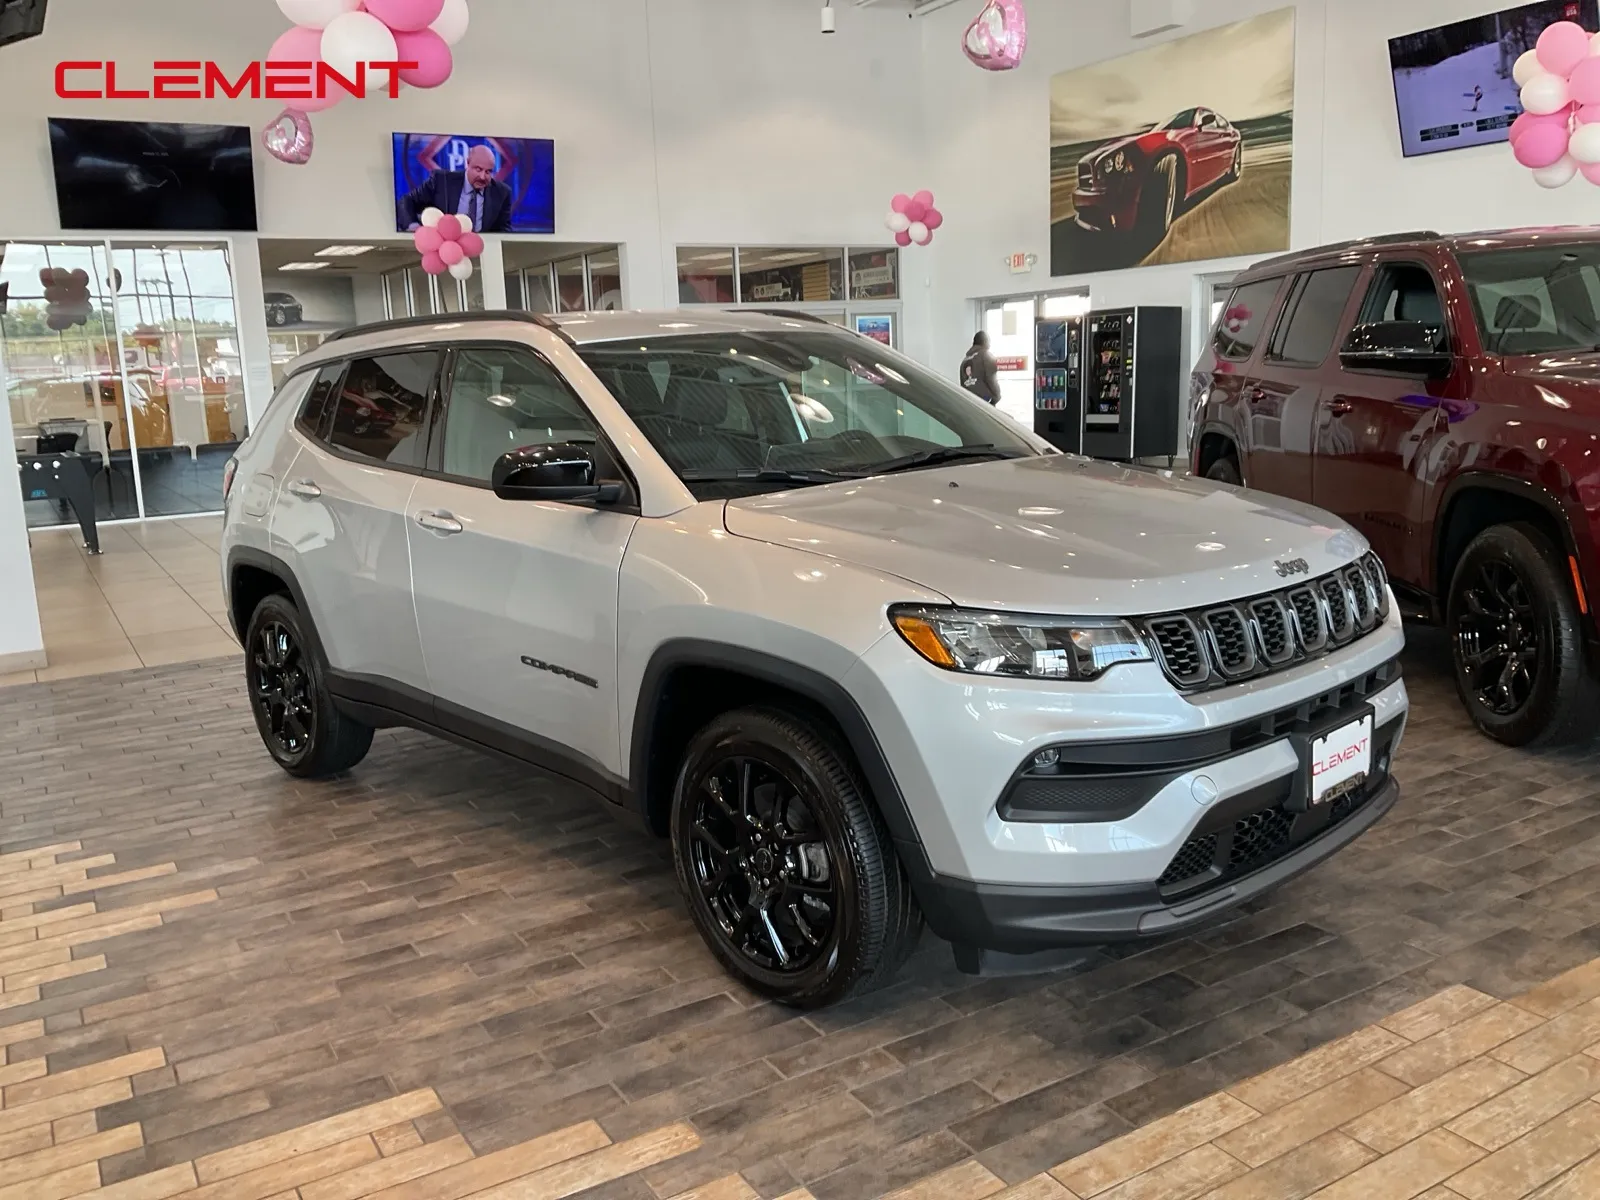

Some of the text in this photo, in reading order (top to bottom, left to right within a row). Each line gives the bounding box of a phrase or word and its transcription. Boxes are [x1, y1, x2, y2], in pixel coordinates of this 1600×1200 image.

[1013, 254, 1025, 268] EXIT
[1273, 557, 1309, 578] Jeep
[1312, 737, 1368, 776] CLEMENT
